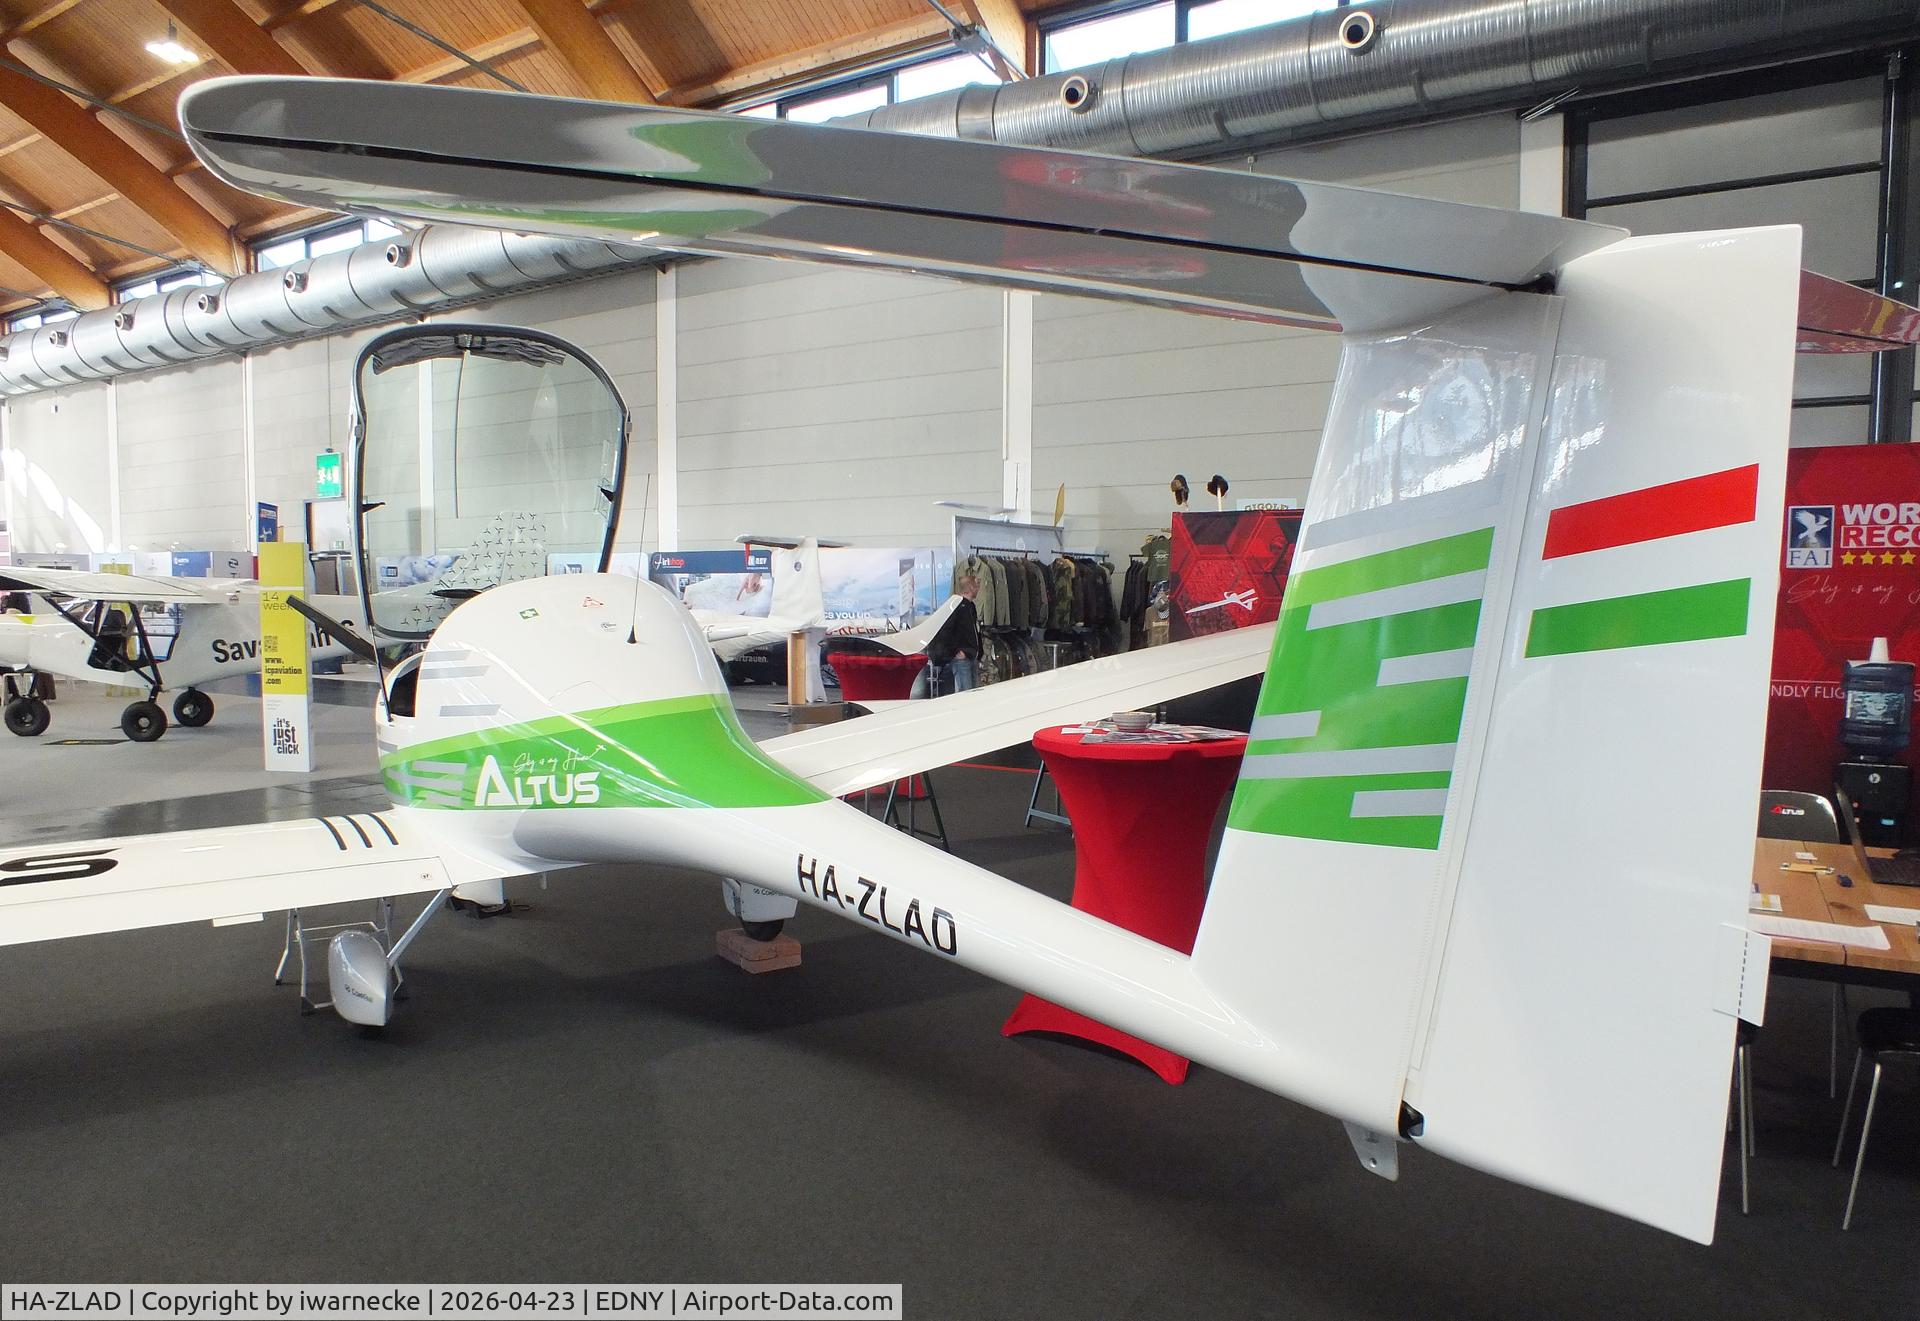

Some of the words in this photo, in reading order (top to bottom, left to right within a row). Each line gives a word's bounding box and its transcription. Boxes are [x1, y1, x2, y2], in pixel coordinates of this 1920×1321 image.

[1789, 550, 1831, 566] FAI
[475, 754, 601, 807] ALTUS
[797, 853, 958, 956] HA-ZLAD
